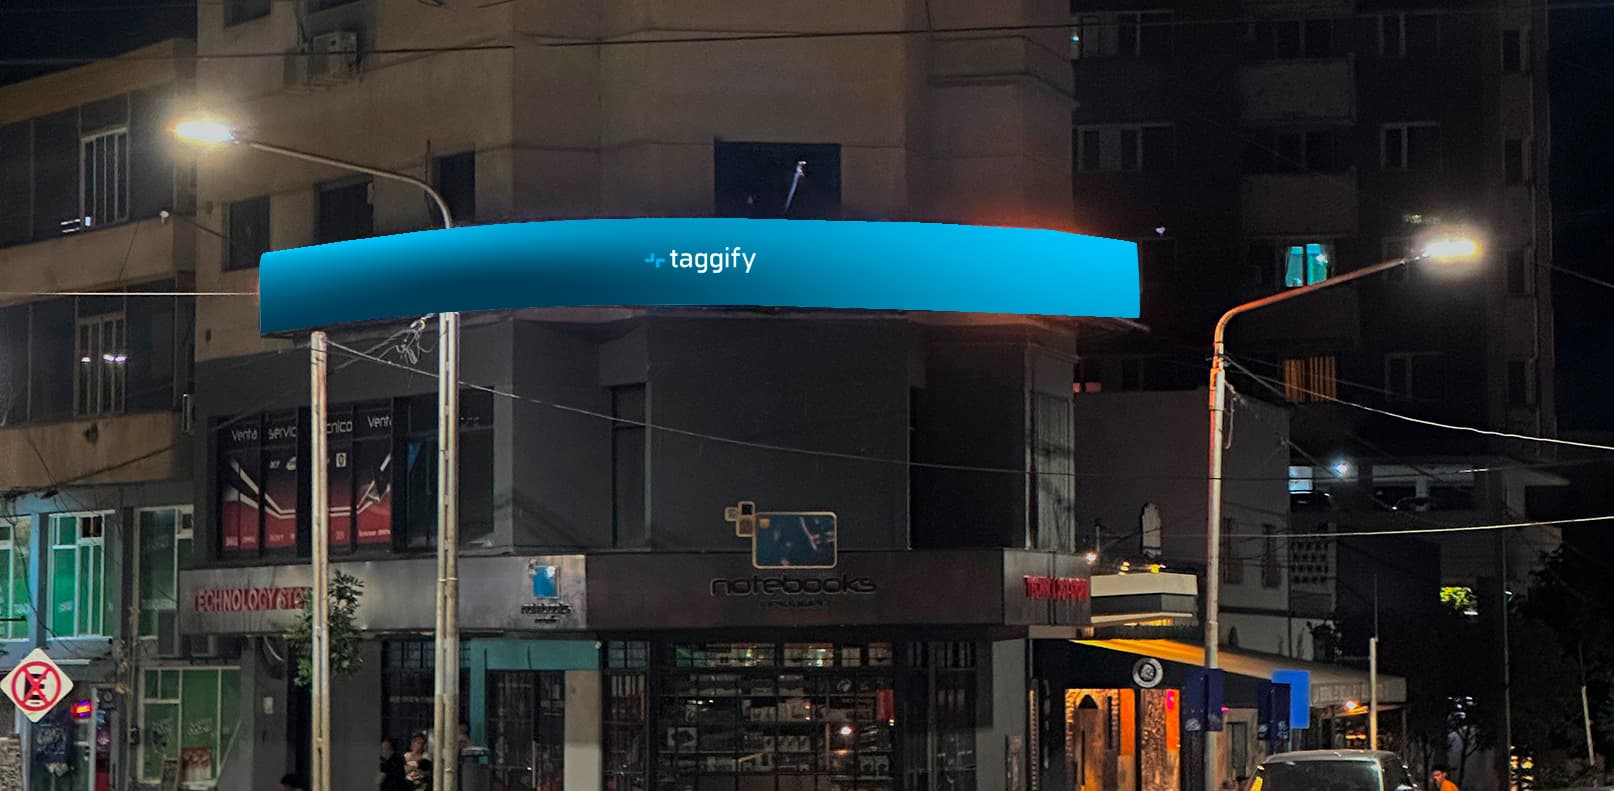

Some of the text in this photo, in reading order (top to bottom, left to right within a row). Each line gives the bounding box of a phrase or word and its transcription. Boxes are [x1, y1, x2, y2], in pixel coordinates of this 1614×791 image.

[669, 246, 757, 274] taggify
[268, 424, 297, 440] servic
[326, 420, 353, 434] cnico
[710, 574, 877, 596] notebooks
